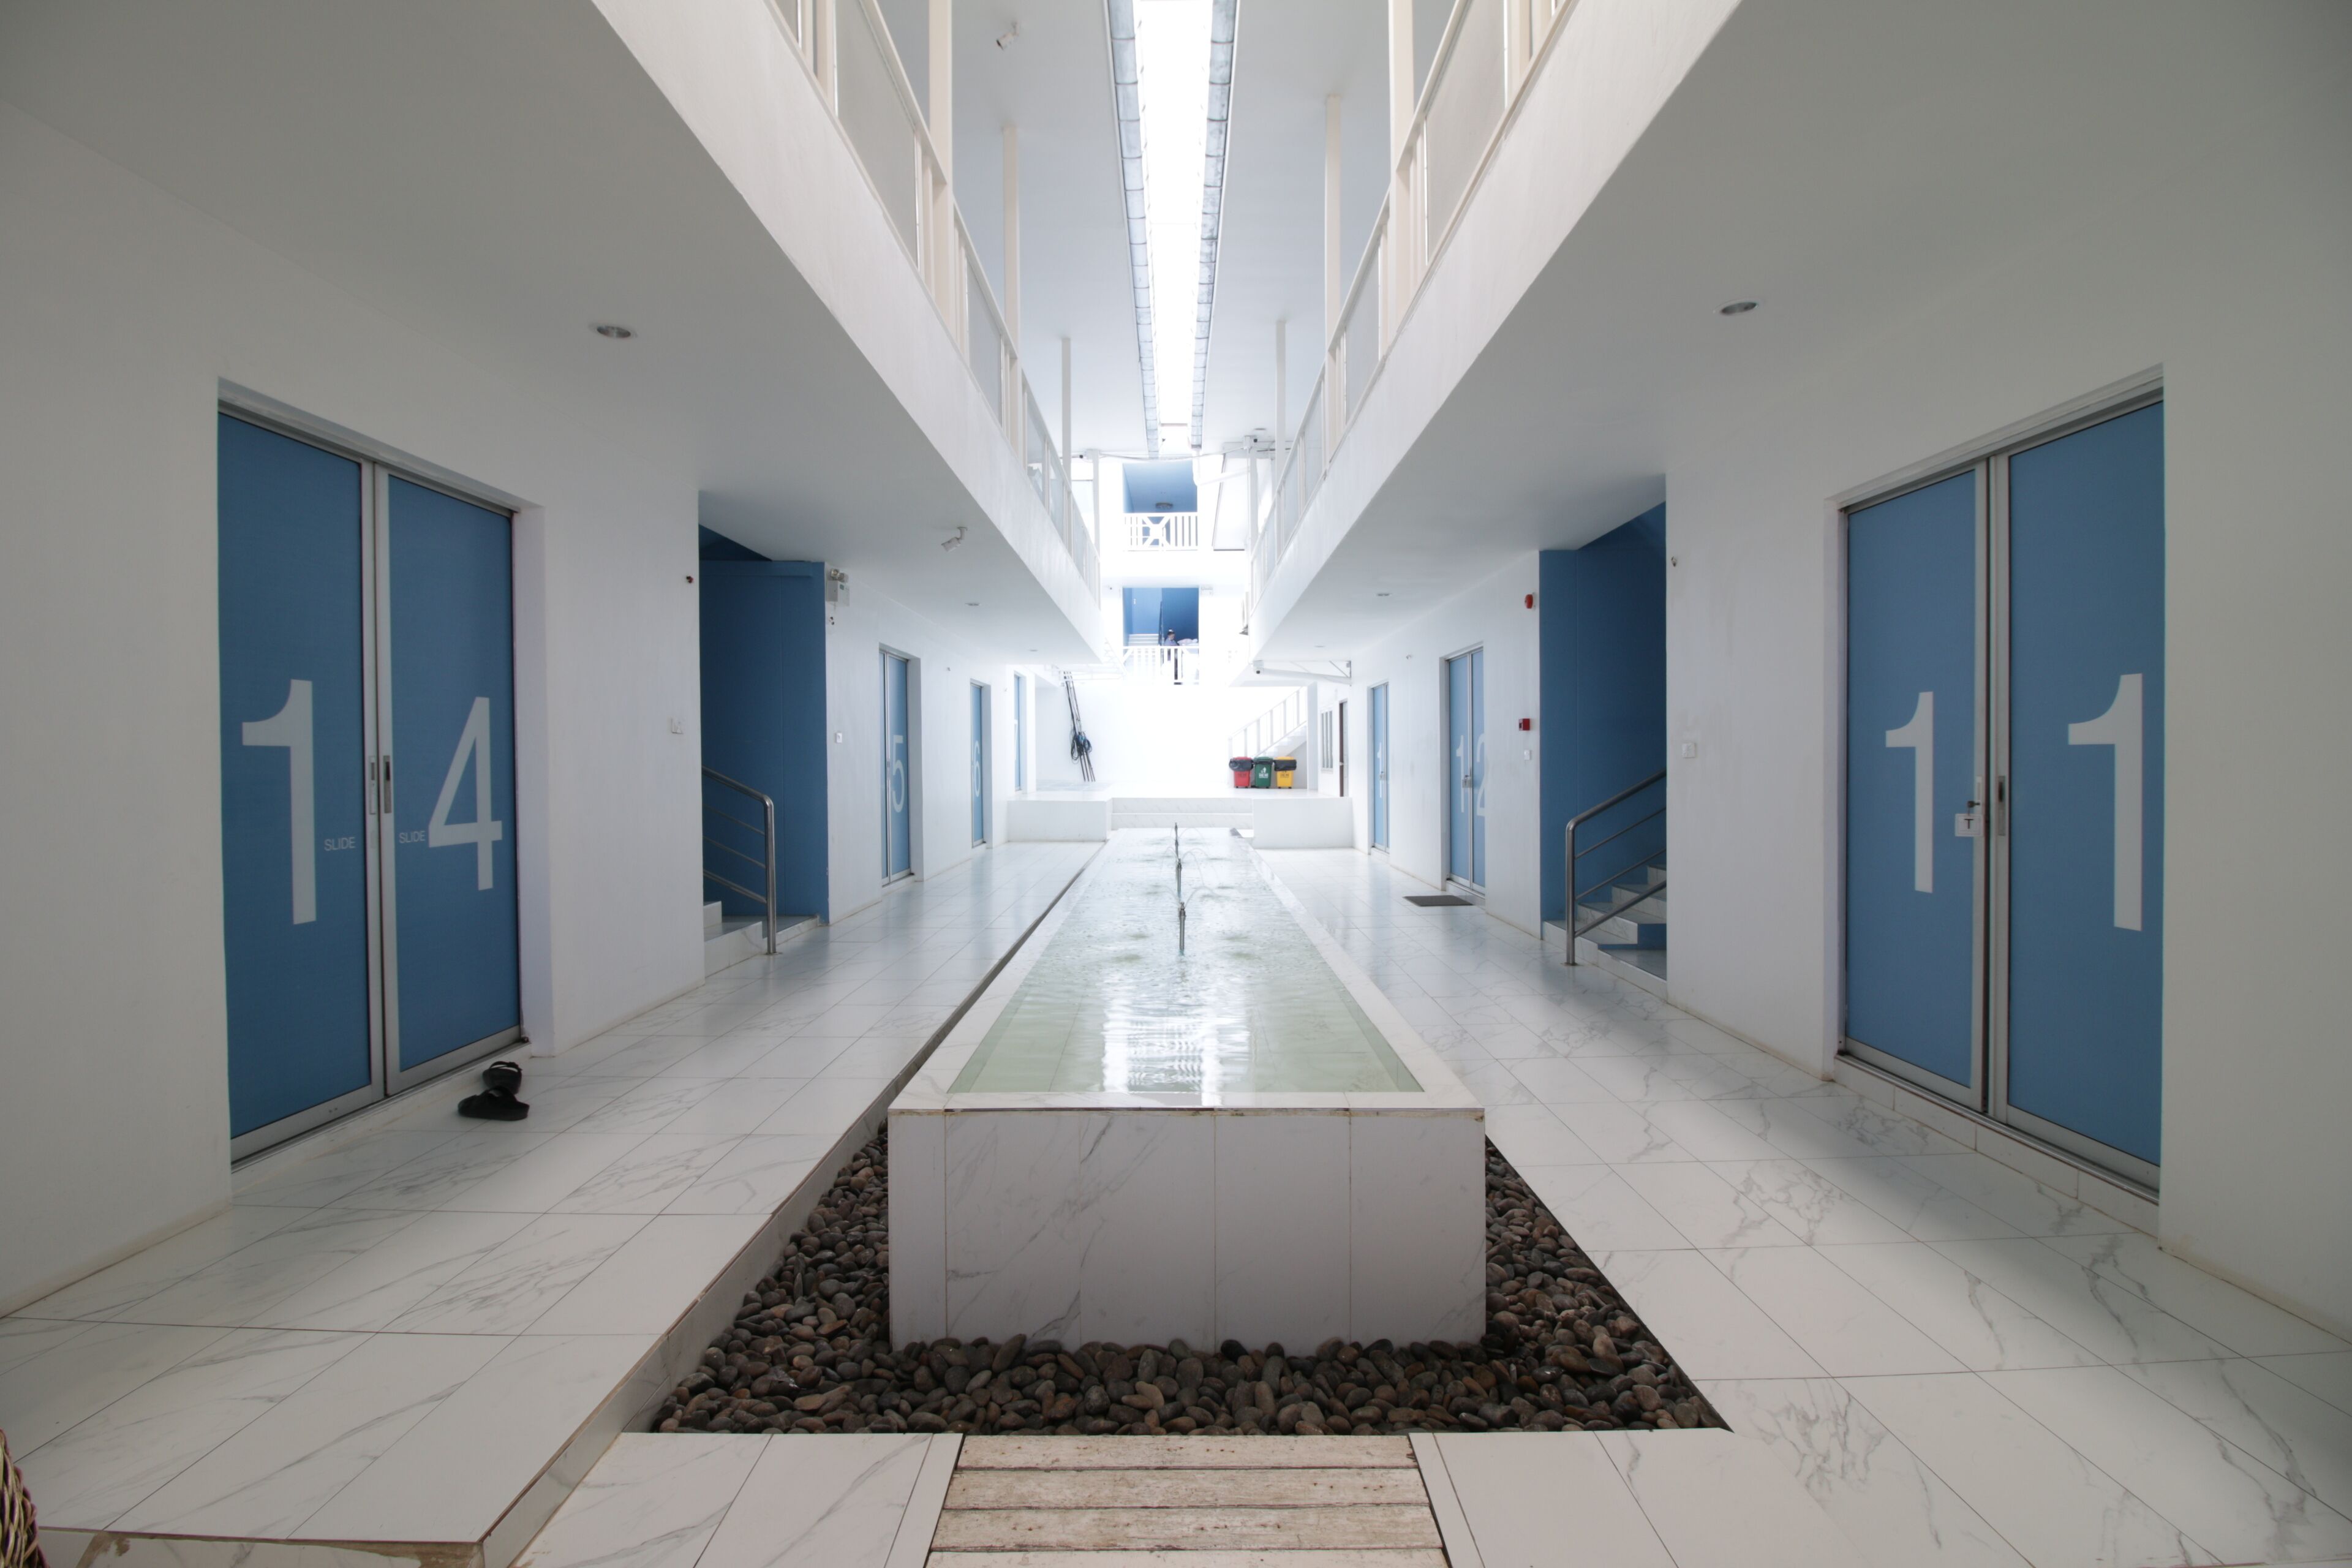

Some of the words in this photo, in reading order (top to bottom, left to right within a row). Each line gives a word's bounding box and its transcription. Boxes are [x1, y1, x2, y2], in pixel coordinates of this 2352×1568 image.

[892, 734, 905, 813] 5
[974, 740, 981, 797] 6
[324, 837, 356, 851] SLIDE
[399, 831, 426, 844] SLIDE
